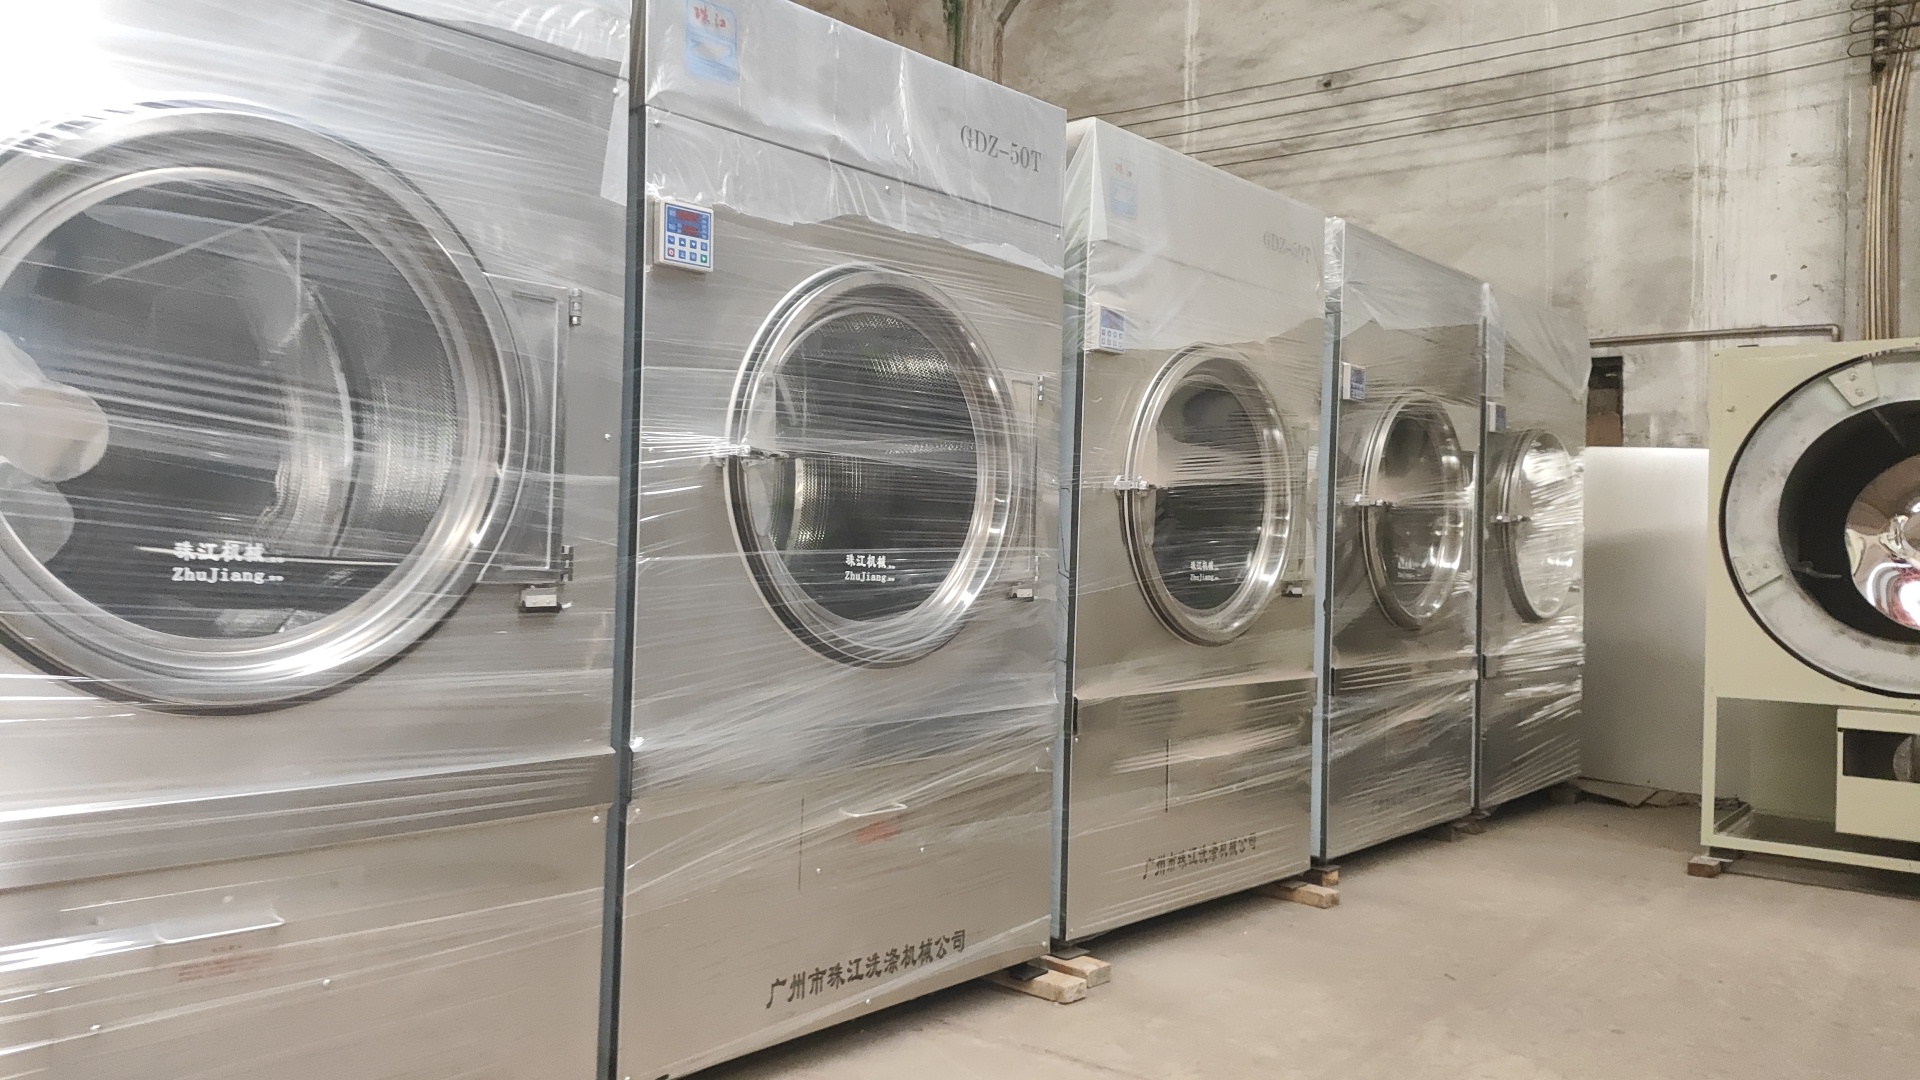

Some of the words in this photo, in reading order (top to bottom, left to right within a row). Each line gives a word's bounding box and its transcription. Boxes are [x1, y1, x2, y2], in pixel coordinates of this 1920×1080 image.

[960, 125, 1042, 172] GDZ-50T
[845, 553, 887, 569] 珠江机械
[171, 566, 266, 585] ZhuJiang
[844, 570, 887, 584] ZhuJiang
[766, 929, 966, 1009] 广州市珠江洗涤机械公司
